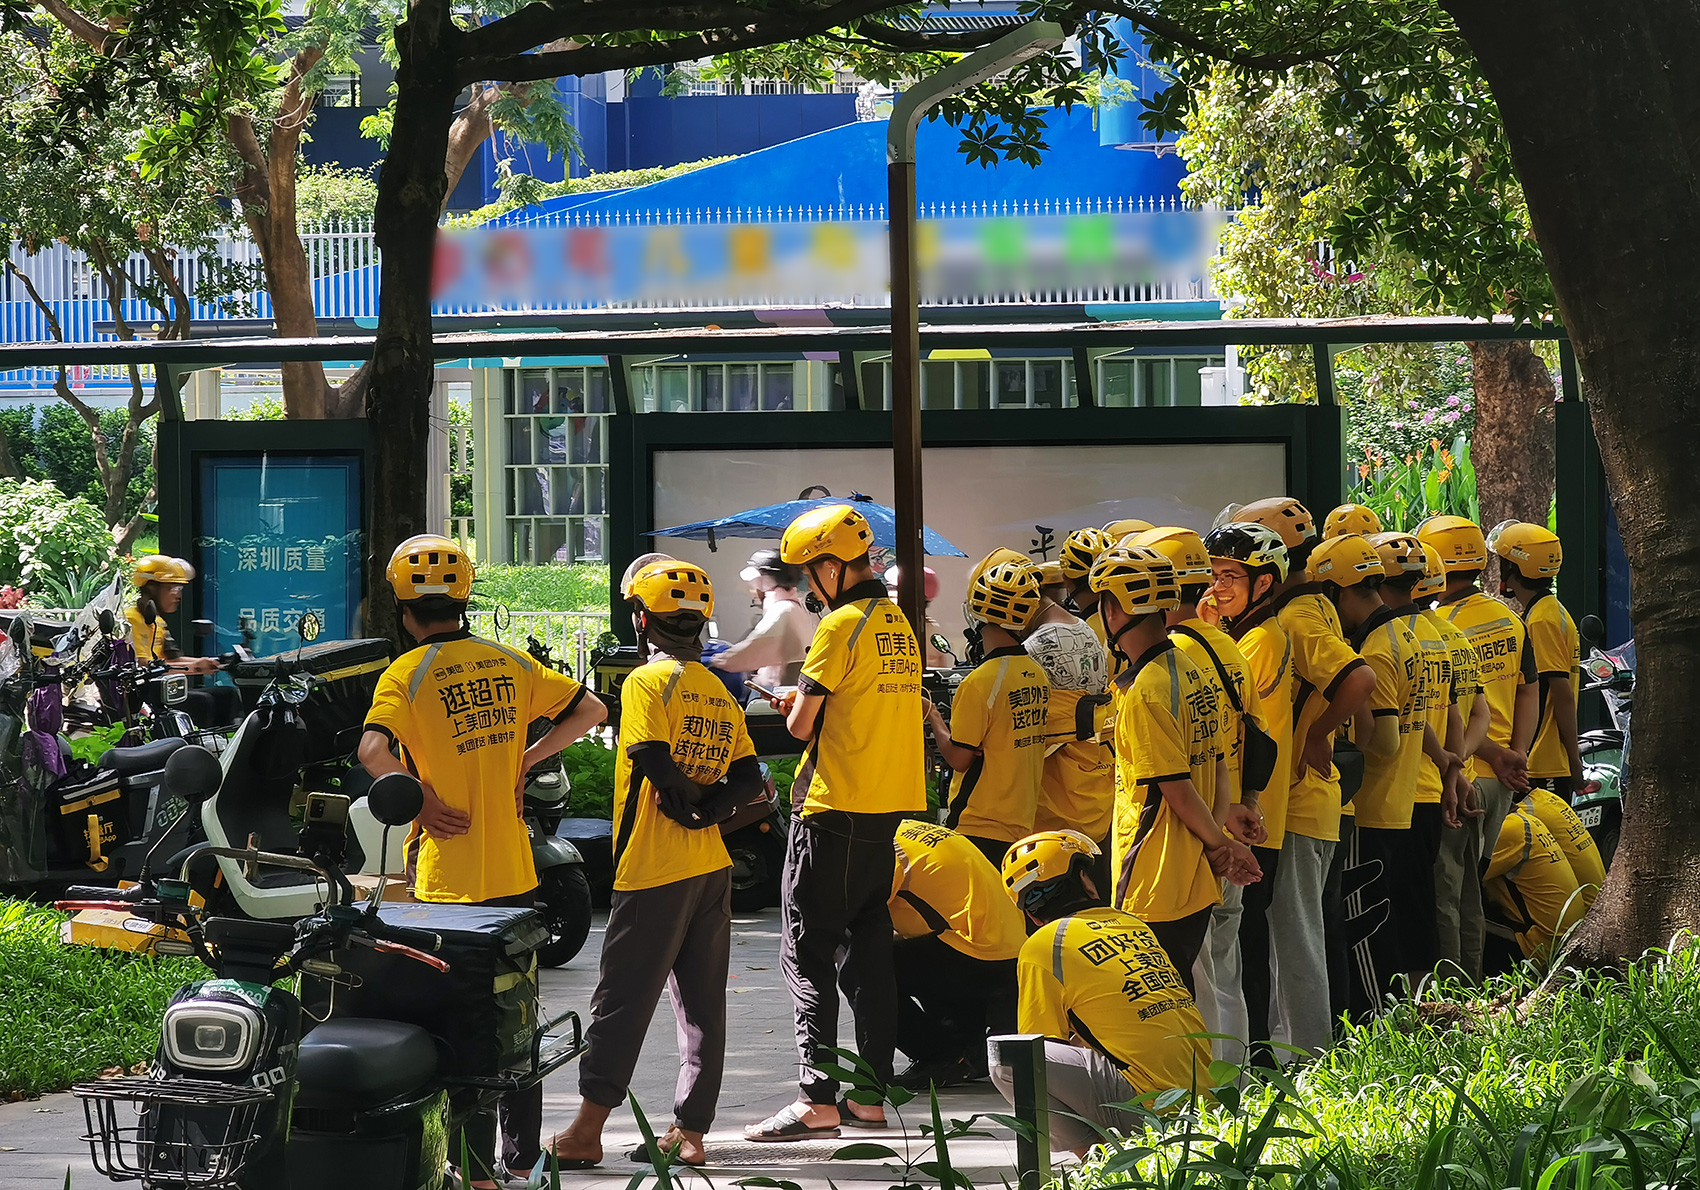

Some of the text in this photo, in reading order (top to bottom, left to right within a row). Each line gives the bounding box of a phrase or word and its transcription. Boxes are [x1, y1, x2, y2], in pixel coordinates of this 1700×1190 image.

[237, 546, 326, 571] 深圳质量
[437, 674, 516, 718] 逛超市
[452, 706, 517, 738] 上美团外卖
